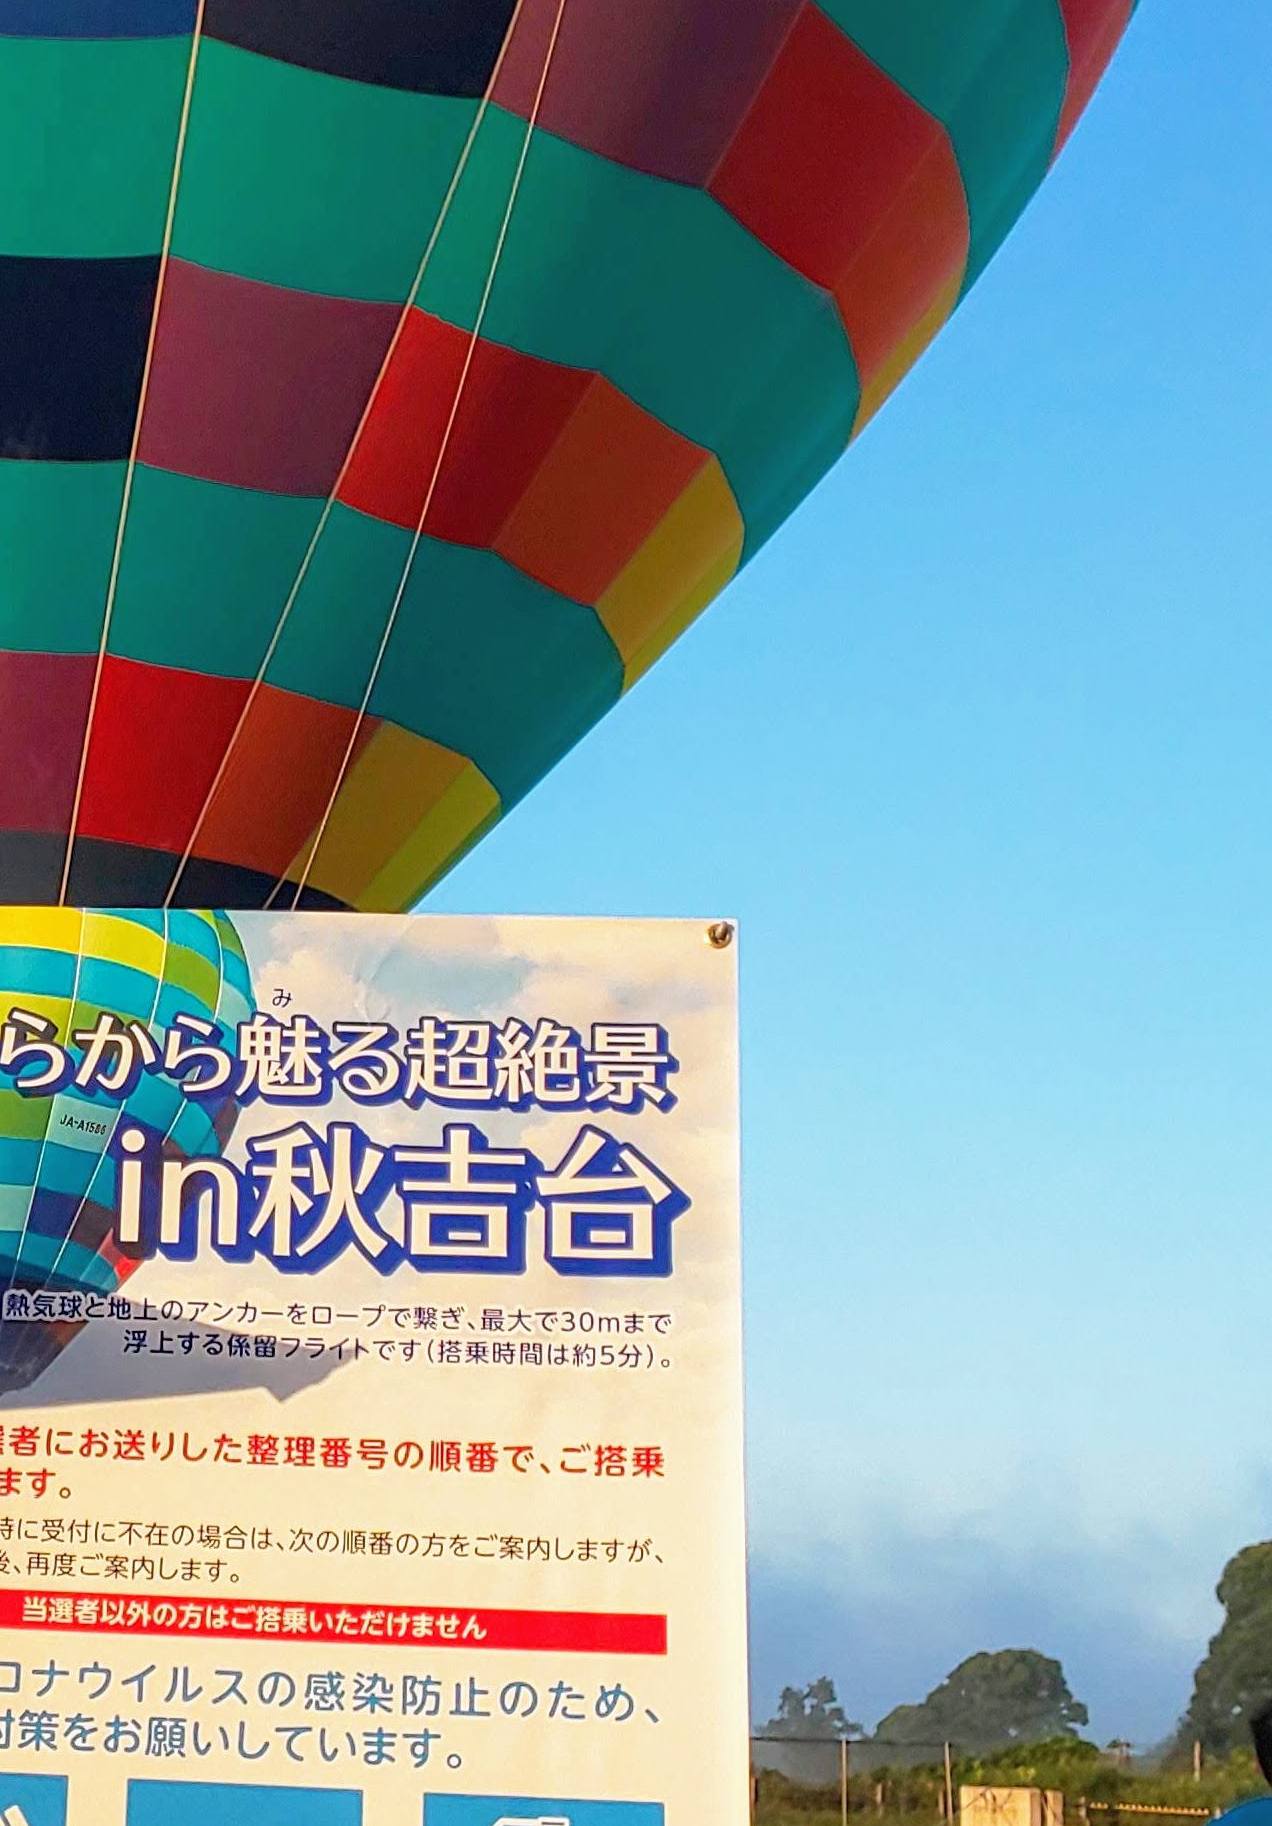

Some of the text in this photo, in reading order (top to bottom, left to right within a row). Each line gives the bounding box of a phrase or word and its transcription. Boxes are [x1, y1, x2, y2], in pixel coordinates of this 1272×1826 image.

[273, 988, 294, 1007] み
[116, 1122, 680, 1268] in秋吉台
[5, 1293, 672, 1334] 熱気球と地上のアンカーをロープで繋ぎ、最大で30mまで
[22, 1595, 488, 1642] 当選者以外の方はご搭乗いただけません
